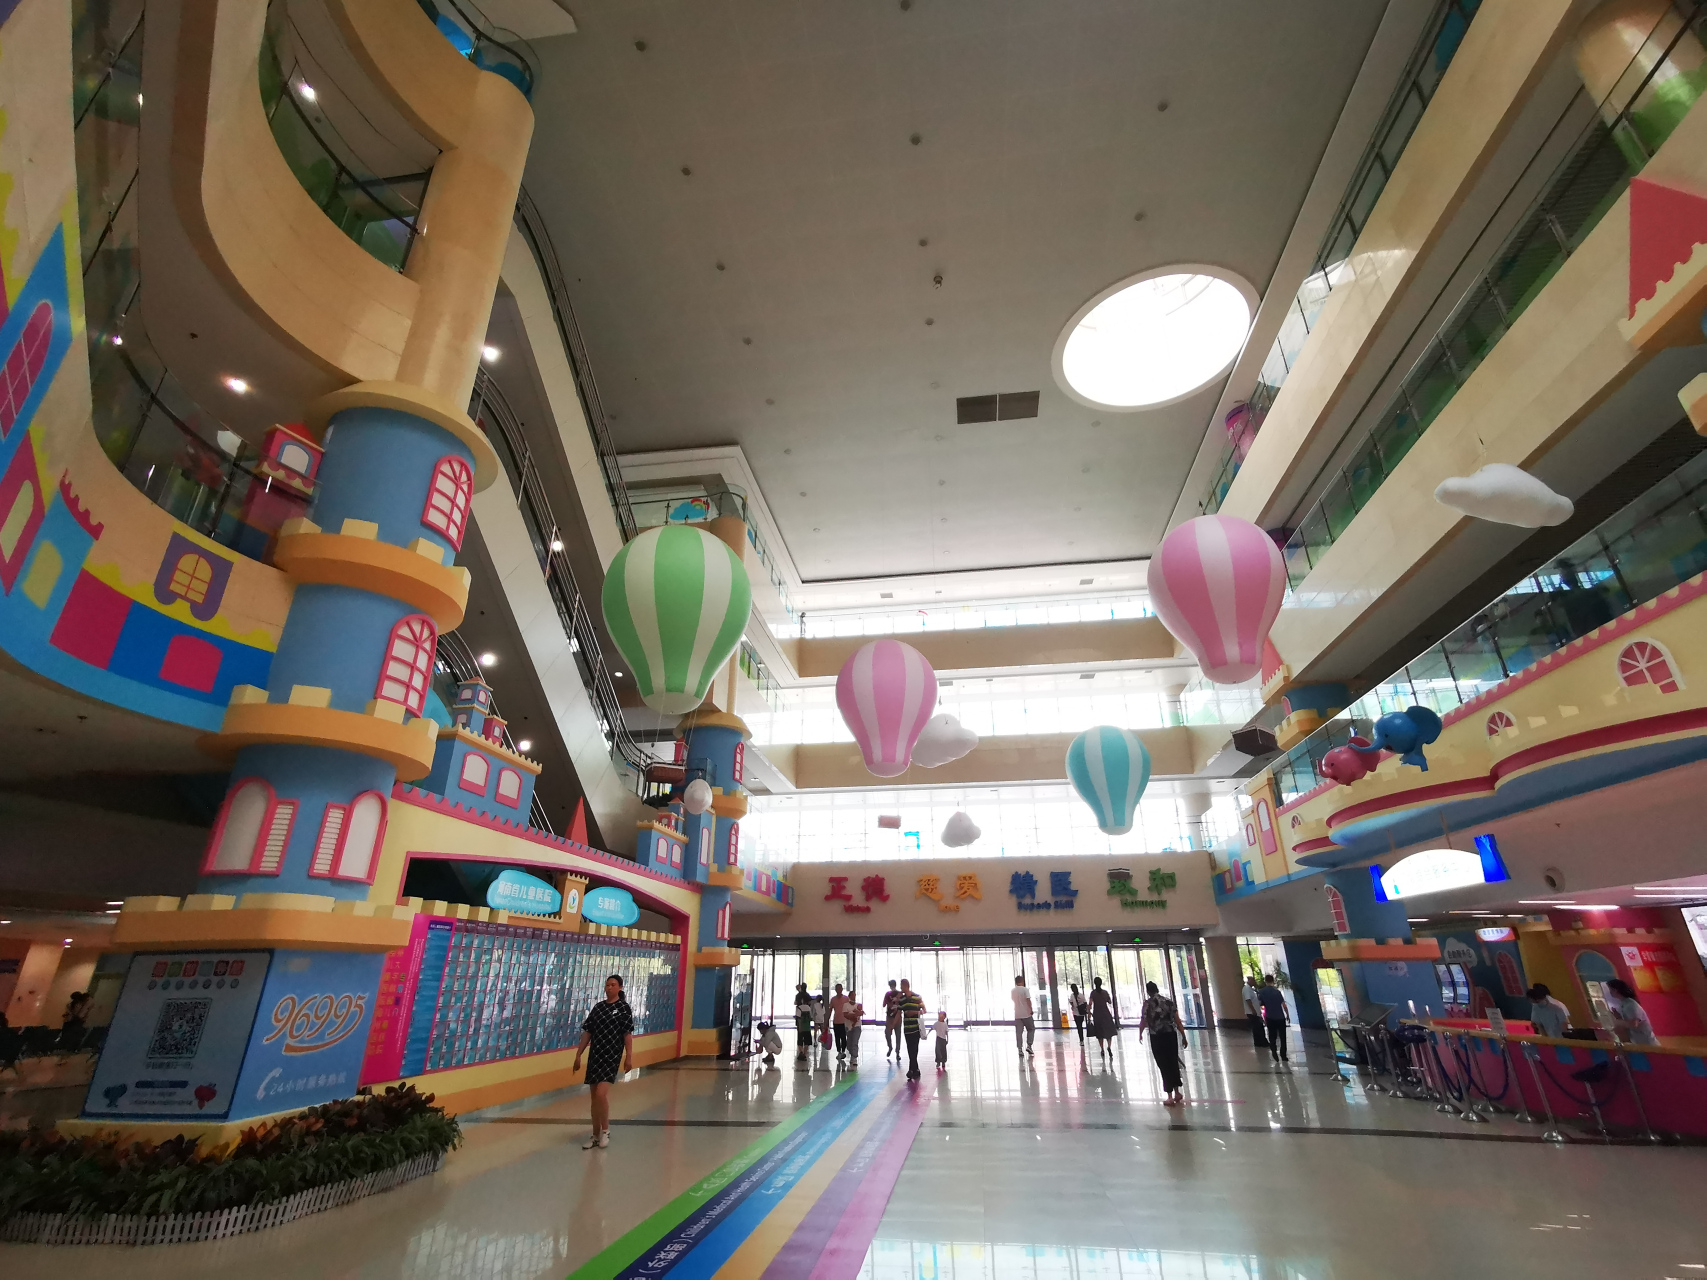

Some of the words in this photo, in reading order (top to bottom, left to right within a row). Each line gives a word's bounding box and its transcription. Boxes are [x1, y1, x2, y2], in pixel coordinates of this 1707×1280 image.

[497, 880, 553, 903] 湖南省儿童医院
[824, 874, 890, 901] 正德
[915, 872, 982, 901] 慈爱
[1009, 870, 1078, 899] 精医
[263, 993, 369, 1055] 96995
